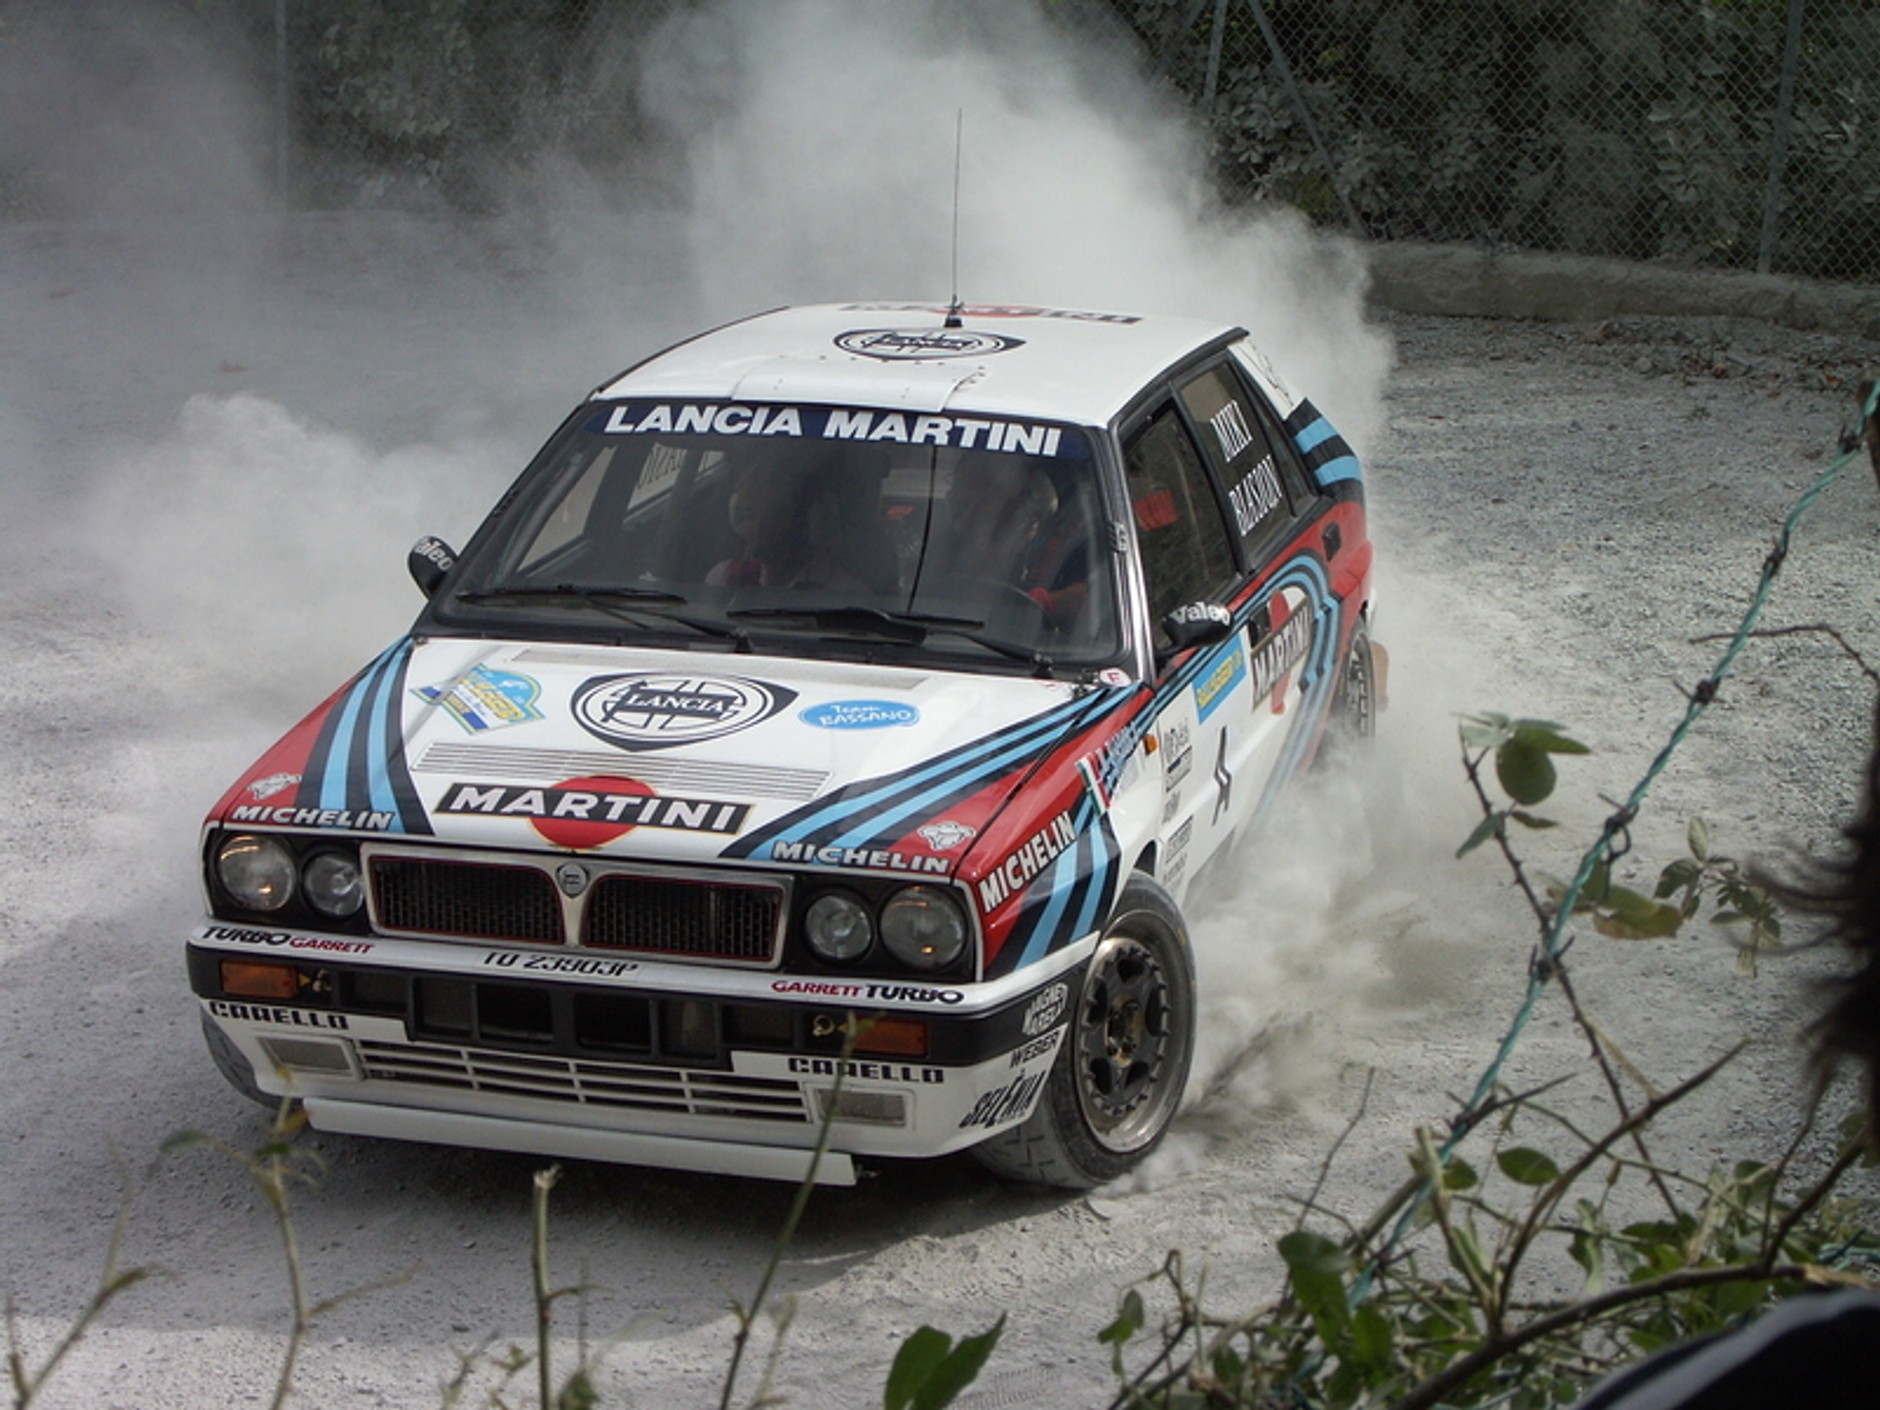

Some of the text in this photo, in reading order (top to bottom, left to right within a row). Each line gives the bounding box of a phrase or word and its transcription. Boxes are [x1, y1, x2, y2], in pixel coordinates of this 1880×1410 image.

[604, 404, 1062, 458] LANCIA MARTINI
[626, 693, 722, 712] LANCIA
[819, 710, 911, 725] BASSANO
[231, 805, 393, 831] MICHELIN
[448, 787, 738, 833] MARTINI
[774, 842, 950, 874] MICHELIN
[979, 810, 1076, 914] MICHELIN
[202, 926, 376, 954] TURBO GARRETT
[771, 980, 965, 1004] GARRETT TURBO
[209, 1001, 349, 1030] CARELLO
